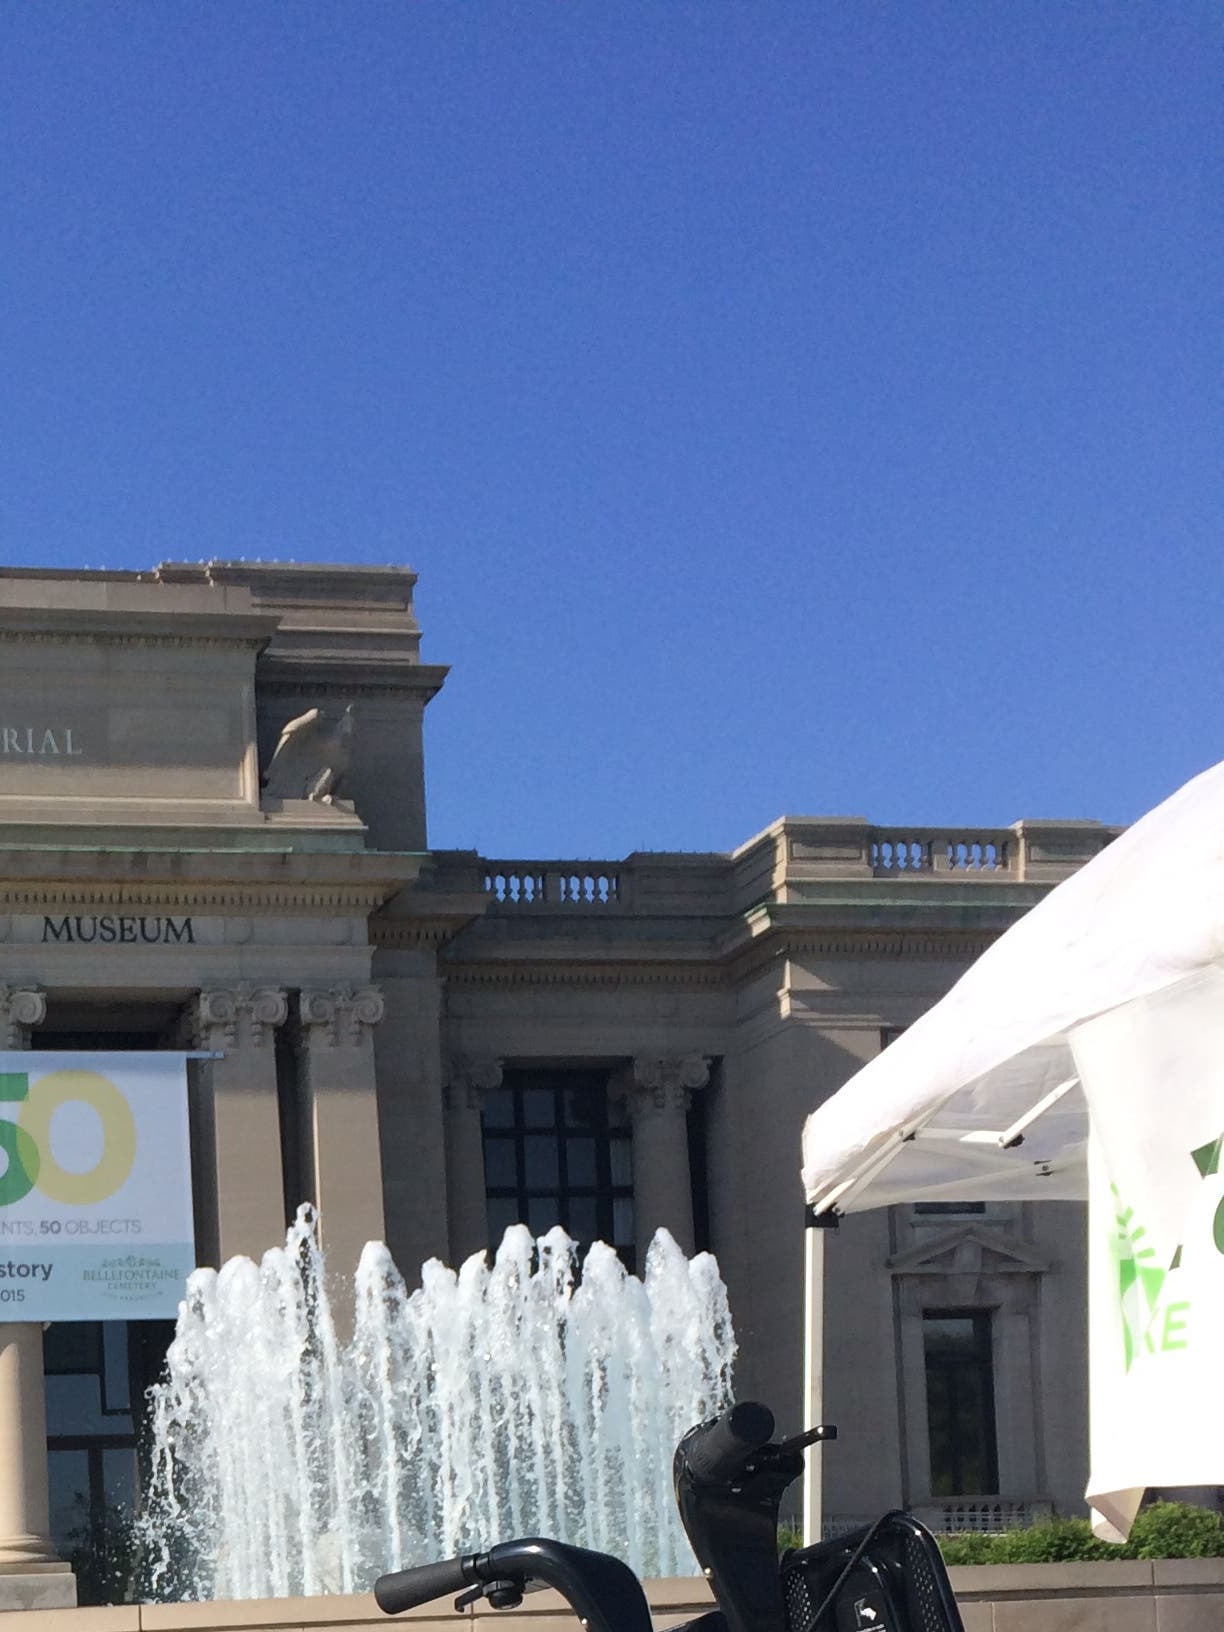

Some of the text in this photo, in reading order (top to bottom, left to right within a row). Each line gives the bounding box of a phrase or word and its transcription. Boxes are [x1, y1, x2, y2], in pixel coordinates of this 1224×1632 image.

[41, 915, 196, 944] MUSEUM
[40, 1220, 62, 1235] 50
[64, 1219, 142, 1236] OBJECTS
